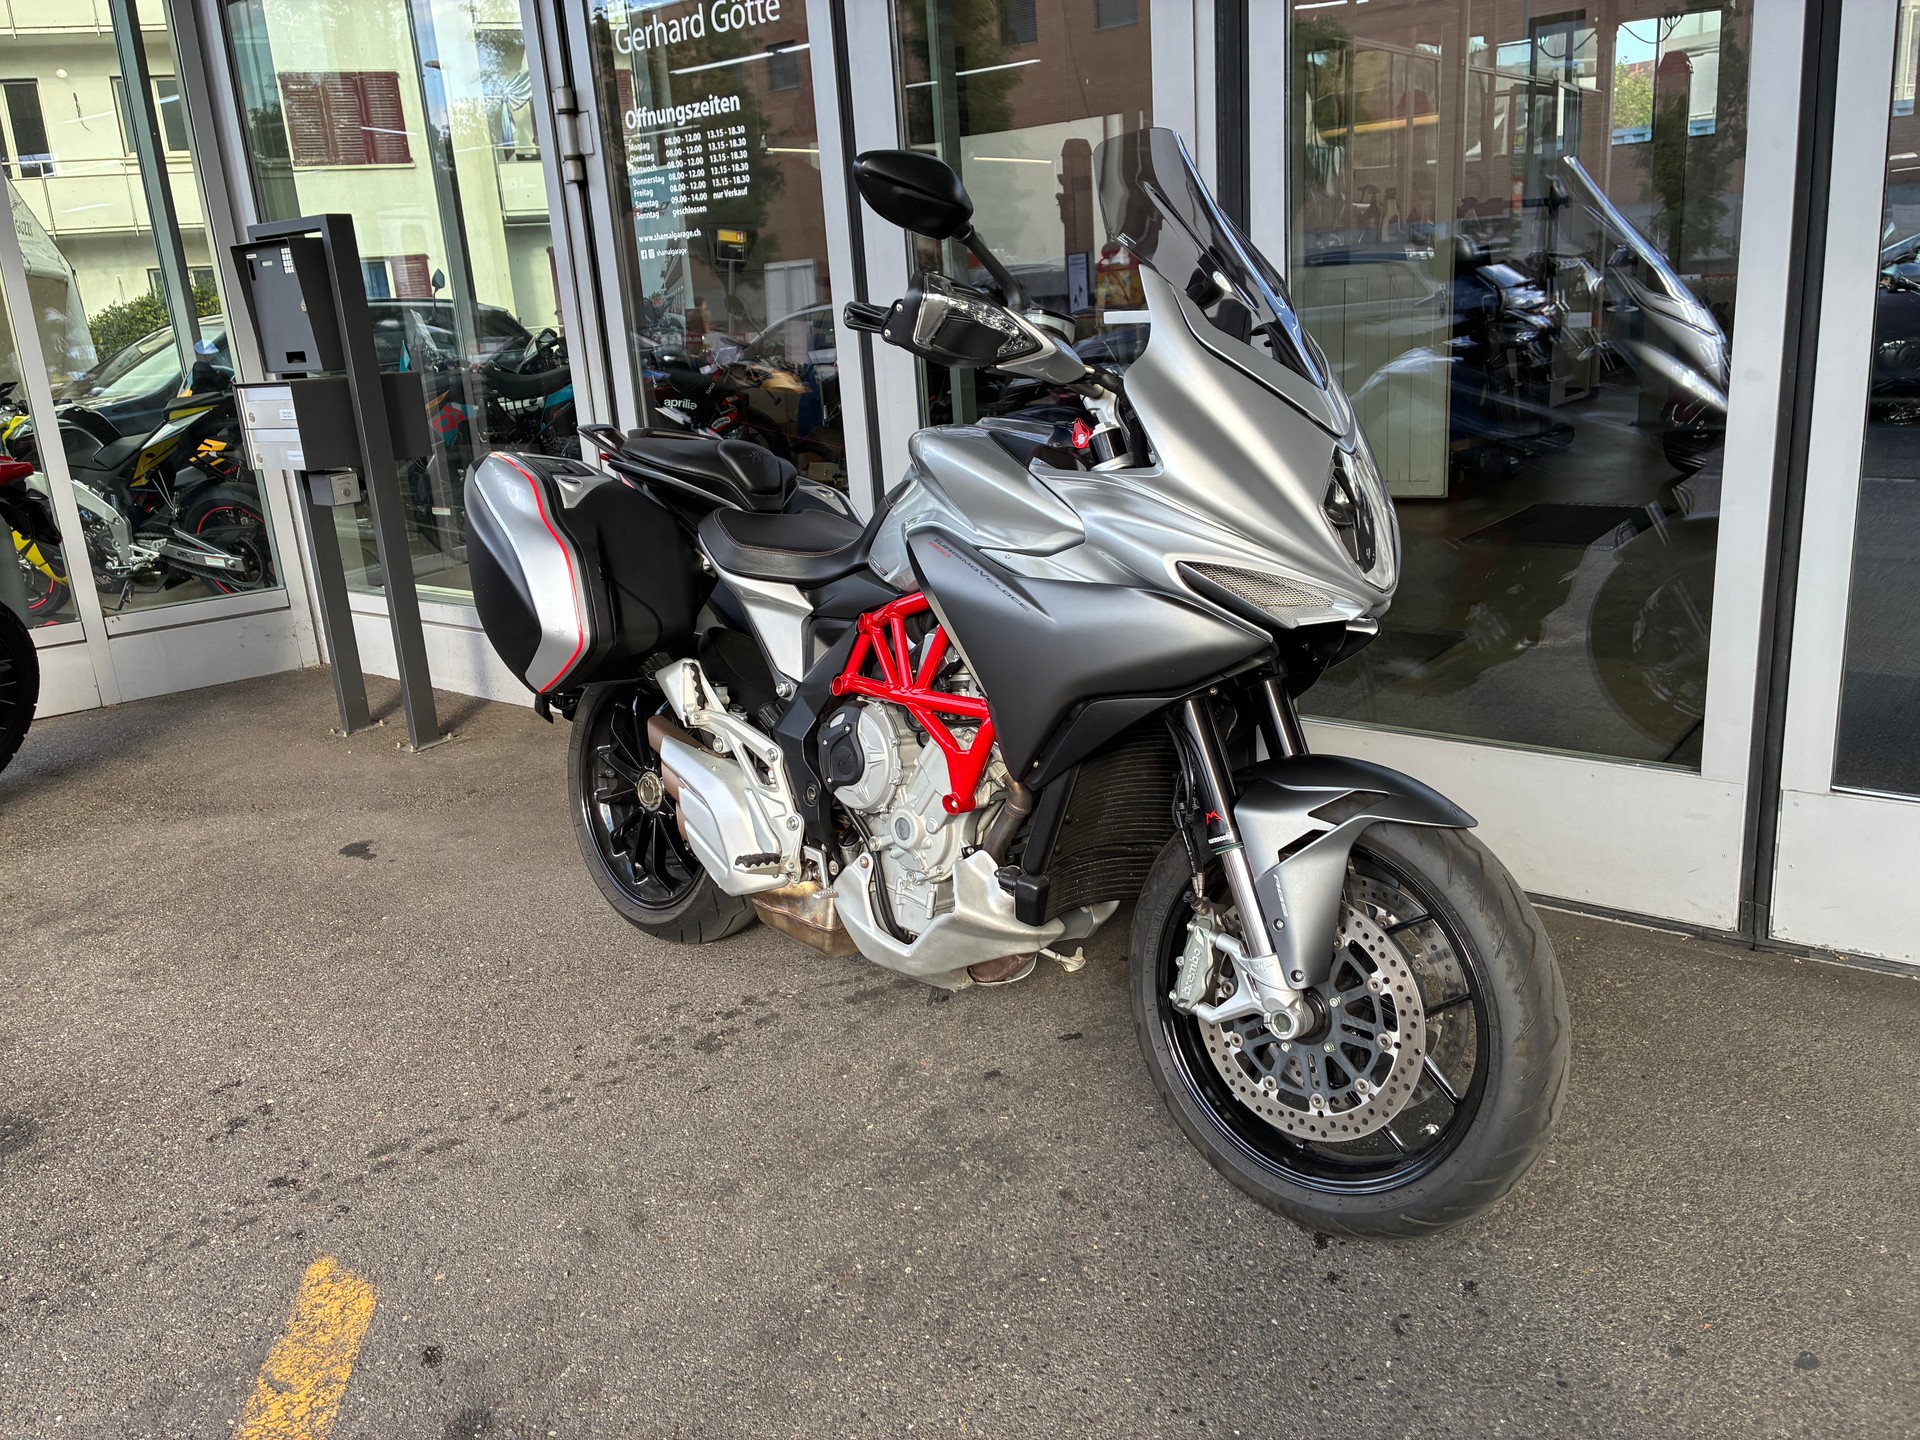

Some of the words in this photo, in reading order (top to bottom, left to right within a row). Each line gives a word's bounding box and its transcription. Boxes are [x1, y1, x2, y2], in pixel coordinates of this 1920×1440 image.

[615, 4, 705, 54] Gerhard
[711, 0, 781, 33] Götte
[629, 142, 650, 151] Montag
[664, 135, 681, 146] 08.00
[684, 132, 702, 142] 12.00
[706, 129, 724, 139] 13.15
[727, 125, 746, 135] 18.30
[630, 153, 655, 163] Dienstag
[665, 148, 682, 158] 08.00
[686, 144, 703, 154] 12.00
[708, 141, 725, 151] 13.15
[729, 137, 747, 148] 18.30
[667, 159, 684, 169] 08.00
[687, 156, 704, 166] 12.00
[709, 153, 727, 163] 13.15
[730, 149, 748, 159] 18.30
[633, 176, 665, 186] Donnerstag
[668, 171, 685, 181] 08.00
[688, 168, 706, 178] 12.00
[710, 165, 728, 175] 13.15
[731, 161, 749, 172] 18.30
[633, 189, 654, 198] Freitag
[669, 183, 686, 193] 08.00
[689, 180, 707, 190] 12.00
[712, 177, 729, 187] 13.15
[732, 174, 750, 184] 18.30
[635, 200, 659, 209] Samstag
[670, 195, 687, 204] 09.00
[691, 192, 708, 202] 14.00
[723, 186, 748, 198] Verkauf
[636, 212, 660, 220] Sonntag
[672, 205, 707, 218] geschlossen
[639, 228, 702, 242] www.shamalgarage.ch
[656, 247, 688, 257] shamalgarage
[663, 398, 698, 410] aprilia
[1181, 947, 1202, 997] brembo
